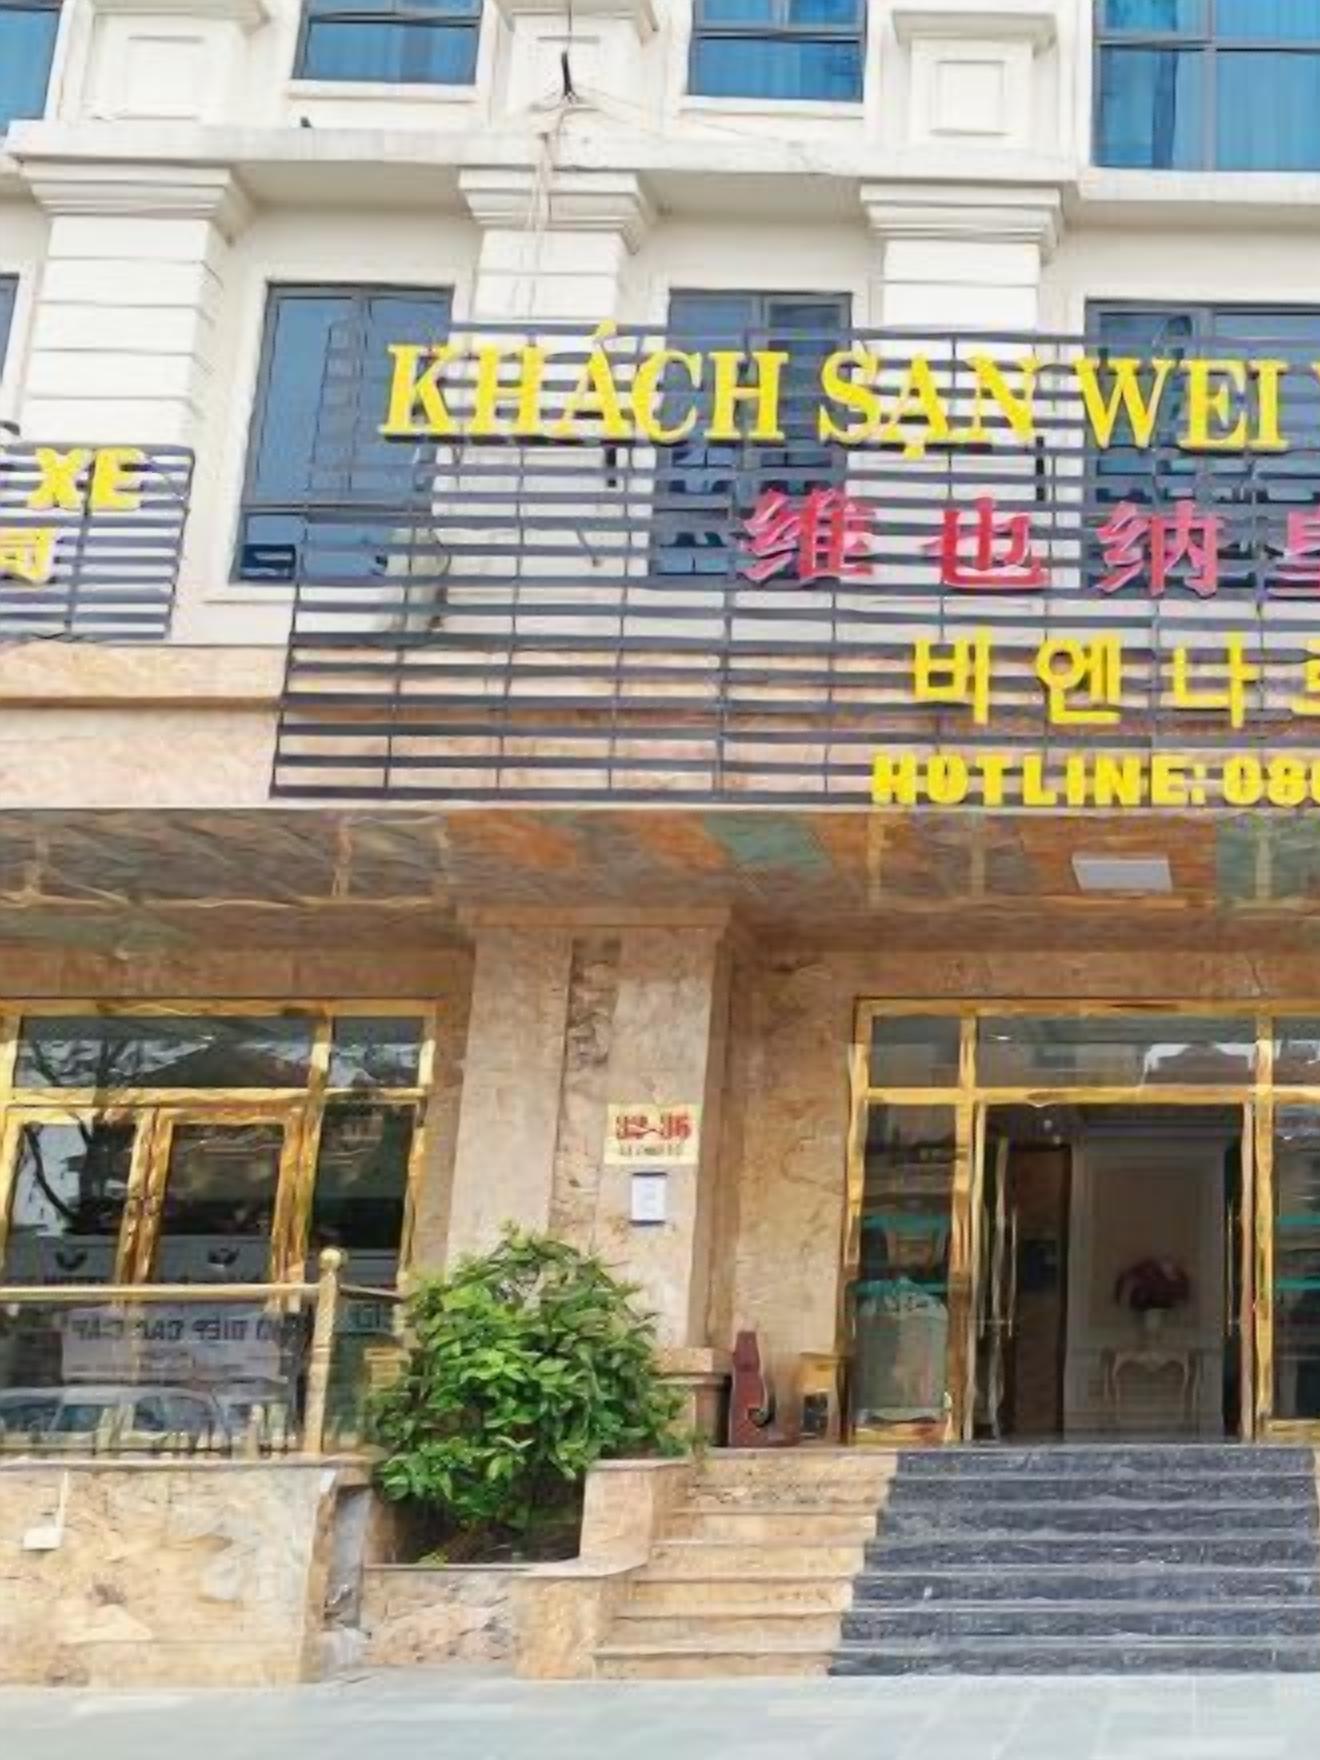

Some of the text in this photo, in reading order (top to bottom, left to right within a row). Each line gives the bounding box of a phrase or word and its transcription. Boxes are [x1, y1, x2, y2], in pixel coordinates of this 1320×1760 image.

[378, 319, 790, 443] KHÁCH
[818, 349, 1038, 459] SẠN
[1071, 356, 1290, 453] WEI
[26, 446, 146, 511] XE
[871, 751, 1206, 808] HOTLINE:
